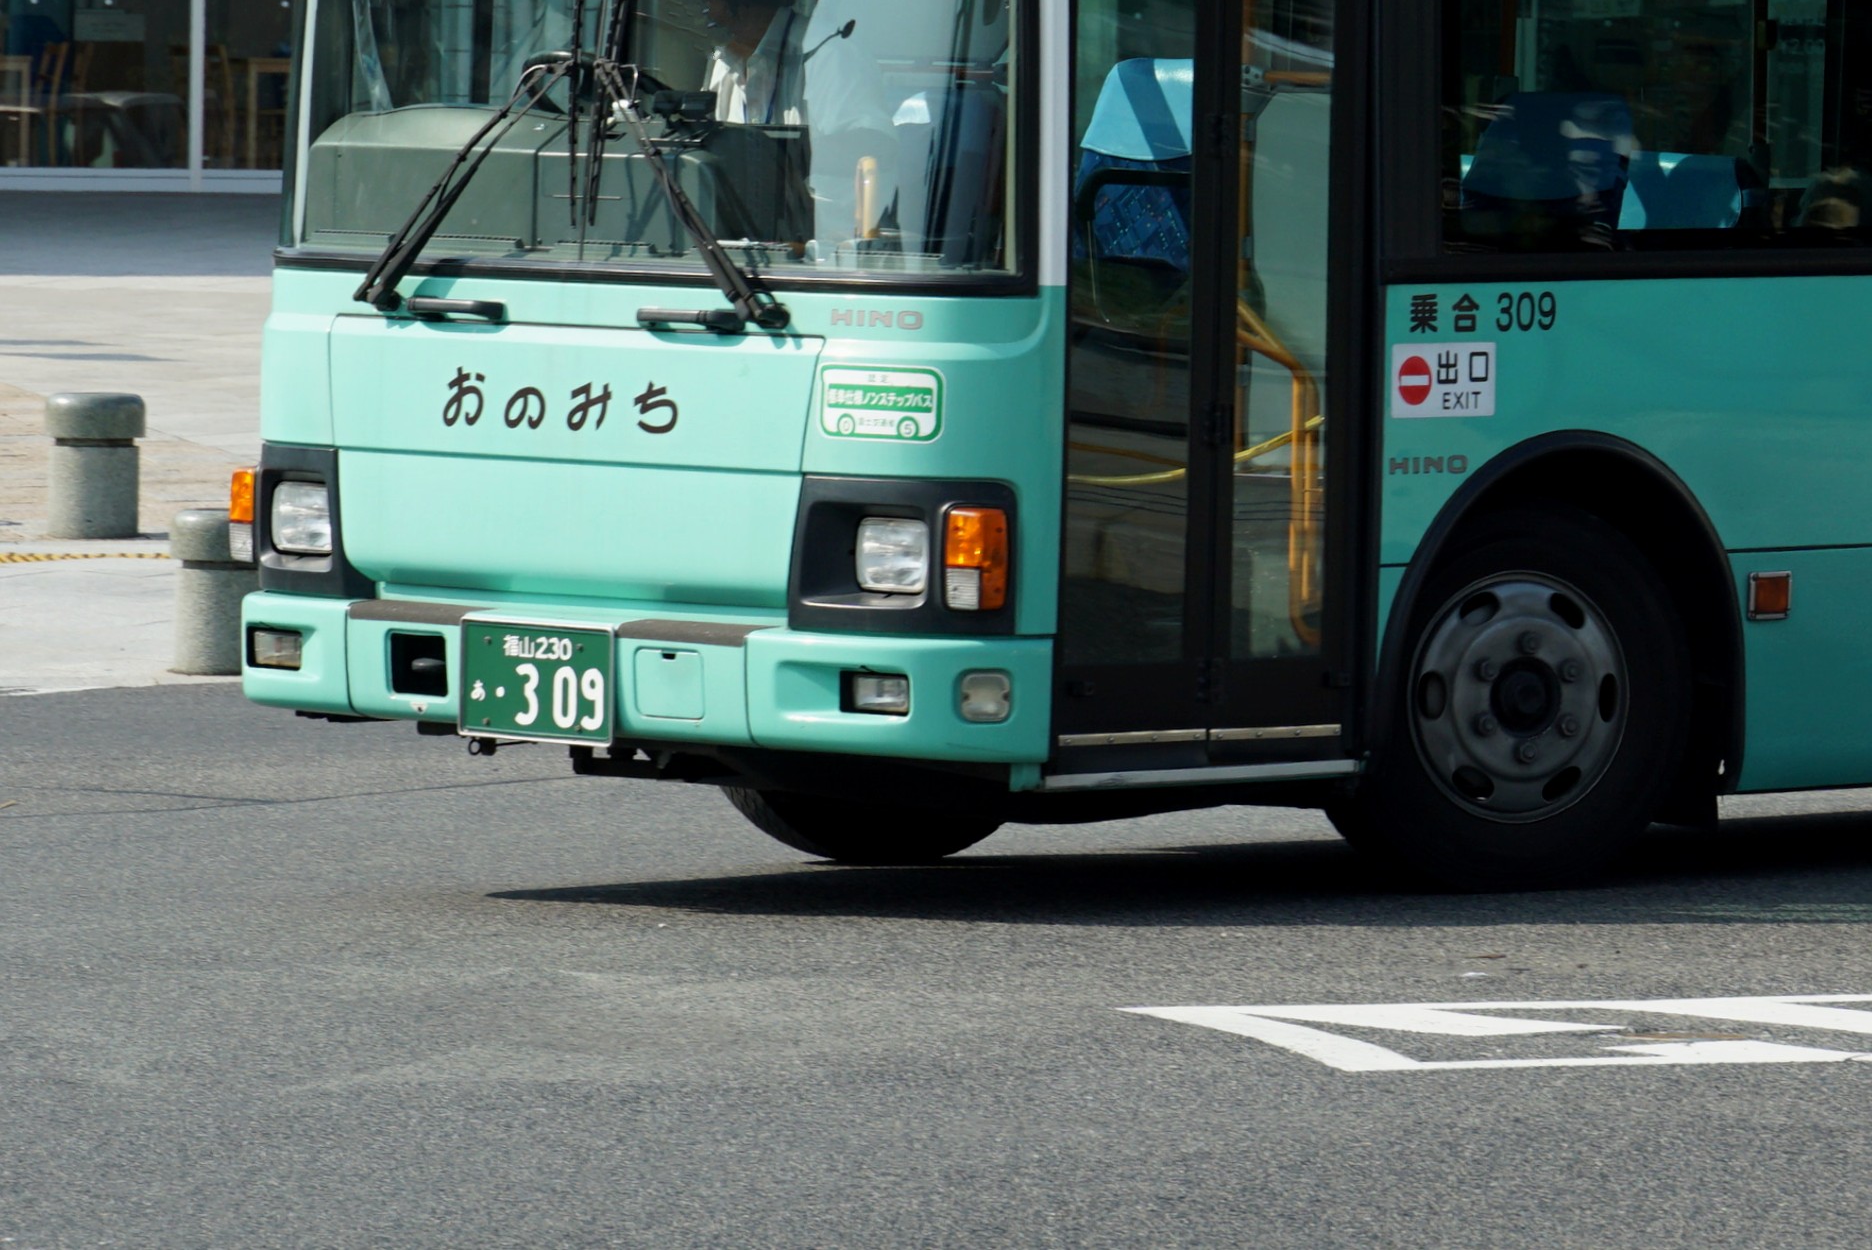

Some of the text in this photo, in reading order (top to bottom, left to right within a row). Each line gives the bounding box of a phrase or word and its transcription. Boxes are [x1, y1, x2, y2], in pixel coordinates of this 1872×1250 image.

[830, 308, 924, 331] HINO
[1409, 291, 1557, 334] 乗合 309
[1436, 350, 1489, 385] 出口
[442, 366, 679, 435] おのみち
[1442, 391, 1482, 410] EXIT
[1388, 454, 1469, 475] HINO
